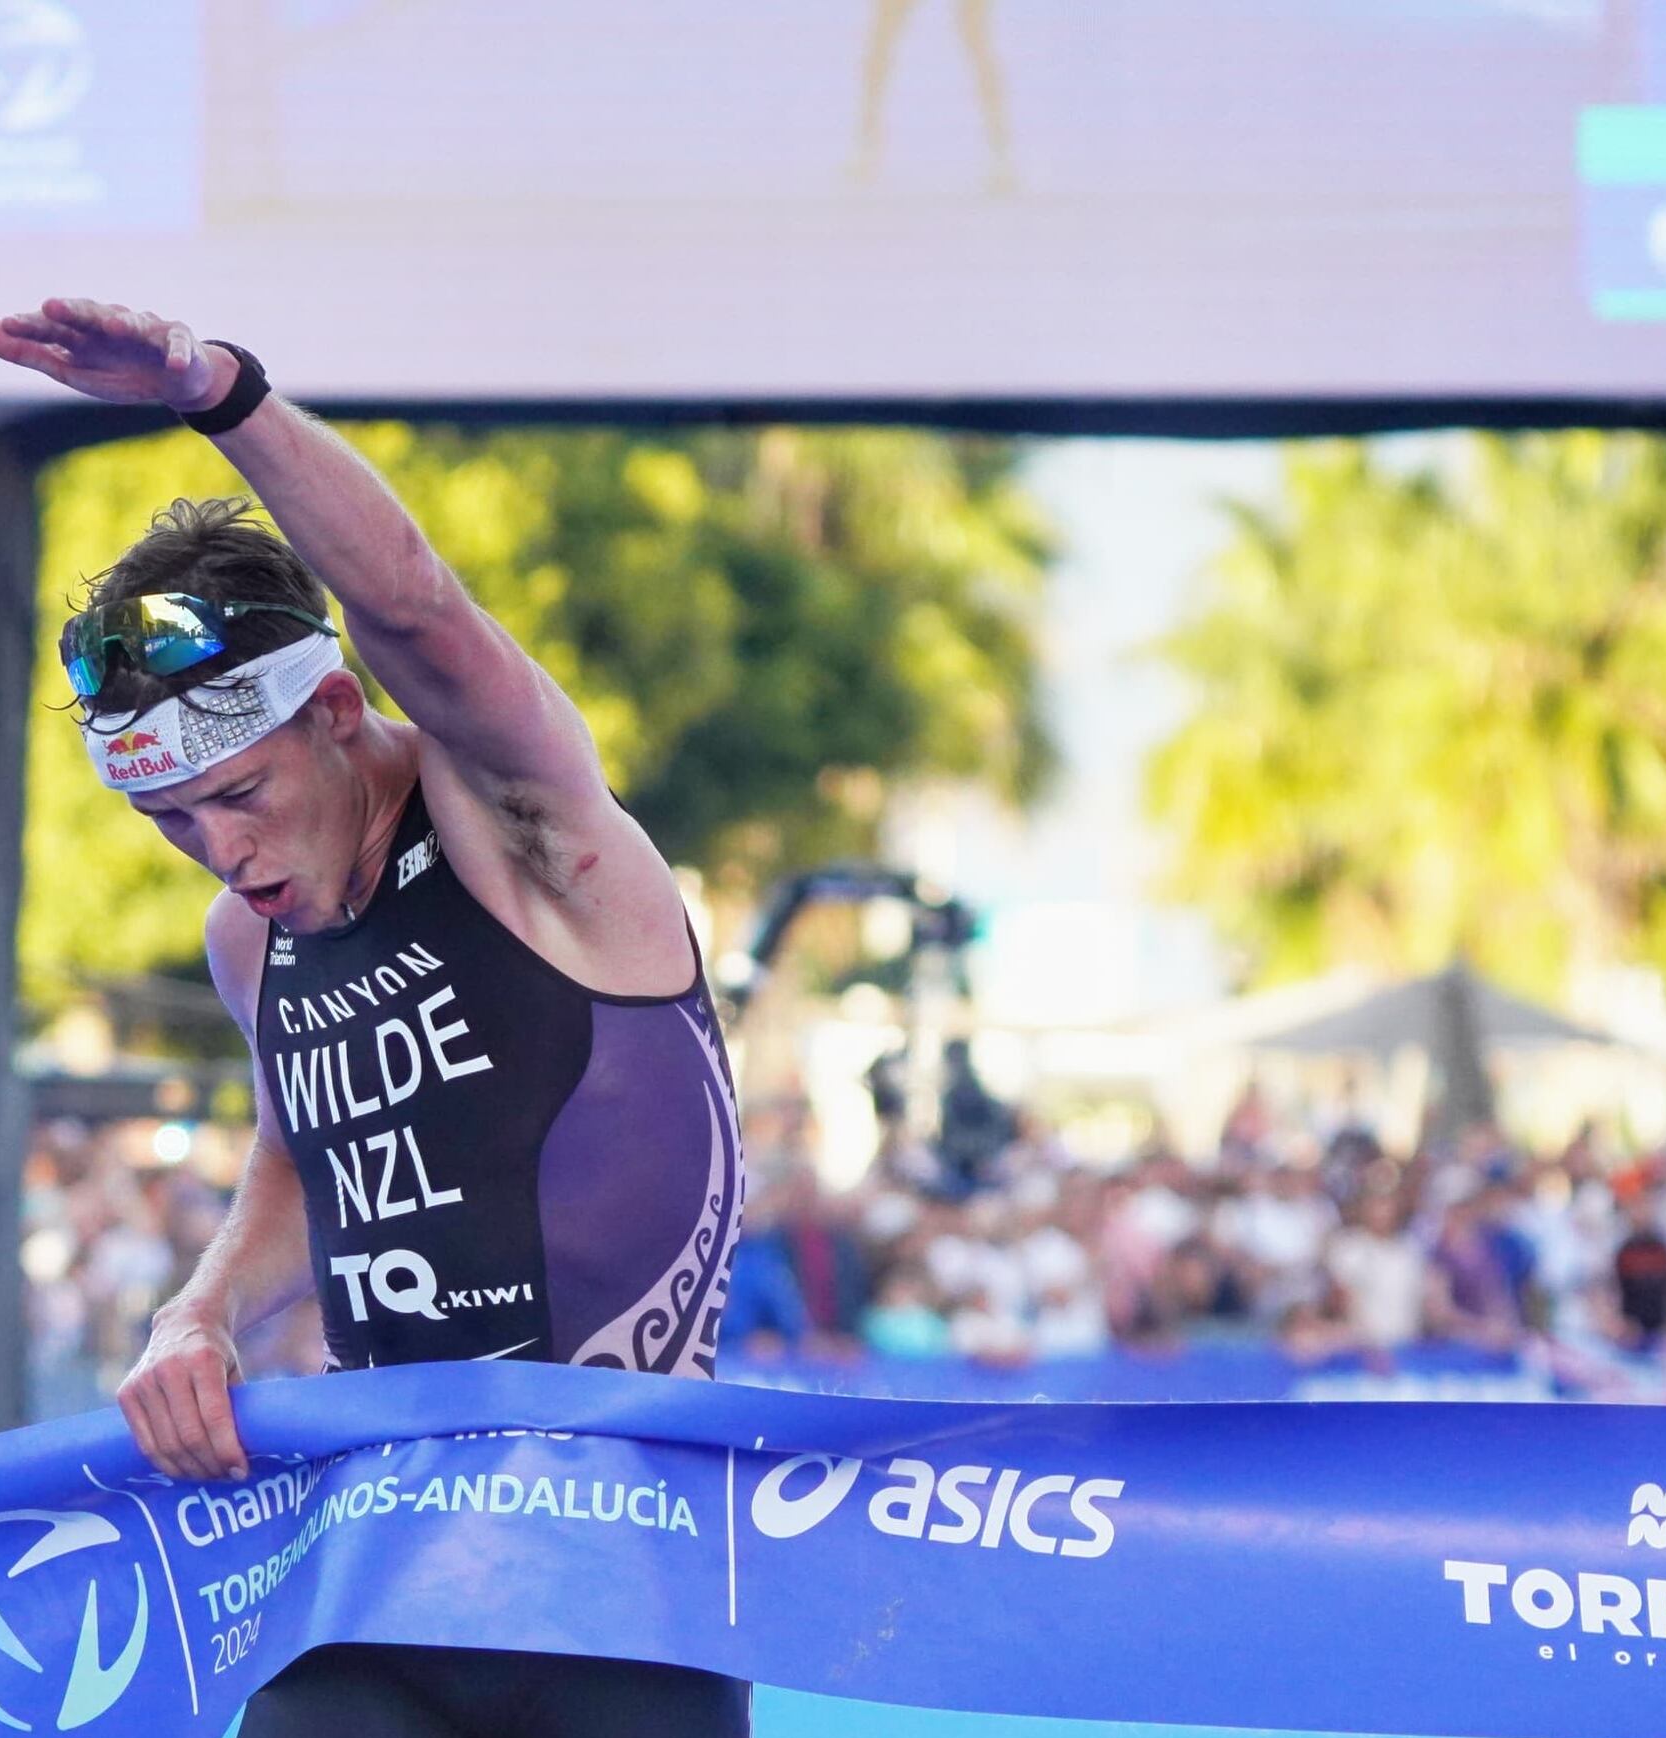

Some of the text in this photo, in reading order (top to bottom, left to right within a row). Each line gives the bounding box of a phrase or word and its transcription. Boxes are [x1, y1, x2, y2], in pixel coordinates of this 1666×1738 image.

[106, 751, 177, 780] Red Bull
[278, 942, 444, 1034] CANYON
[276, 985, 494, 1134] WILDE
[326, 1125, 463, 1229] NZL
[211, 1612, 262, 1674] 2024
[1539, 1642, 1577, 1662] el
